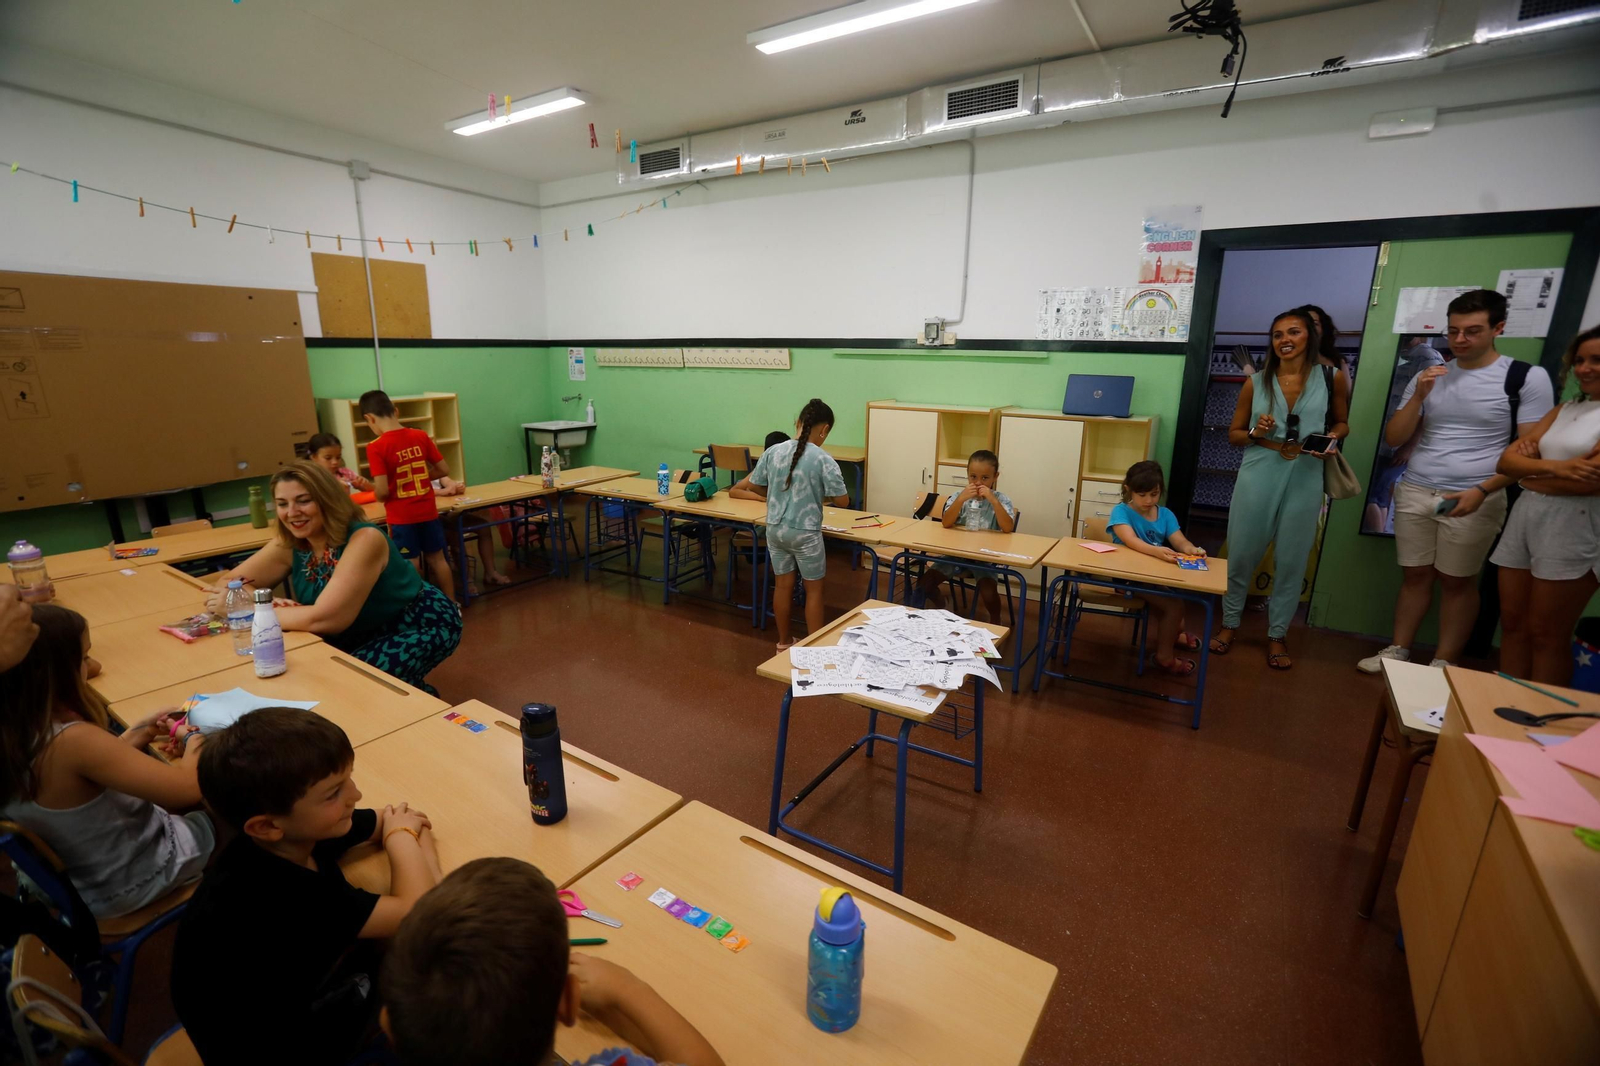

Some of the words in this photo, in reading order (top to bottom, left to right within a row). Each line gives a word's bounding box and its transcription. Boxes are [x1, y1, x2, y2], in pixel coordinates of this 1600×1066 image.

[1147, 230, 1196, 242] ENGLISH
[1147, 241, 1193, 253] CORNER
[396, 446, 422, 463] ISCO
[396, 460, 430, 499] 22
